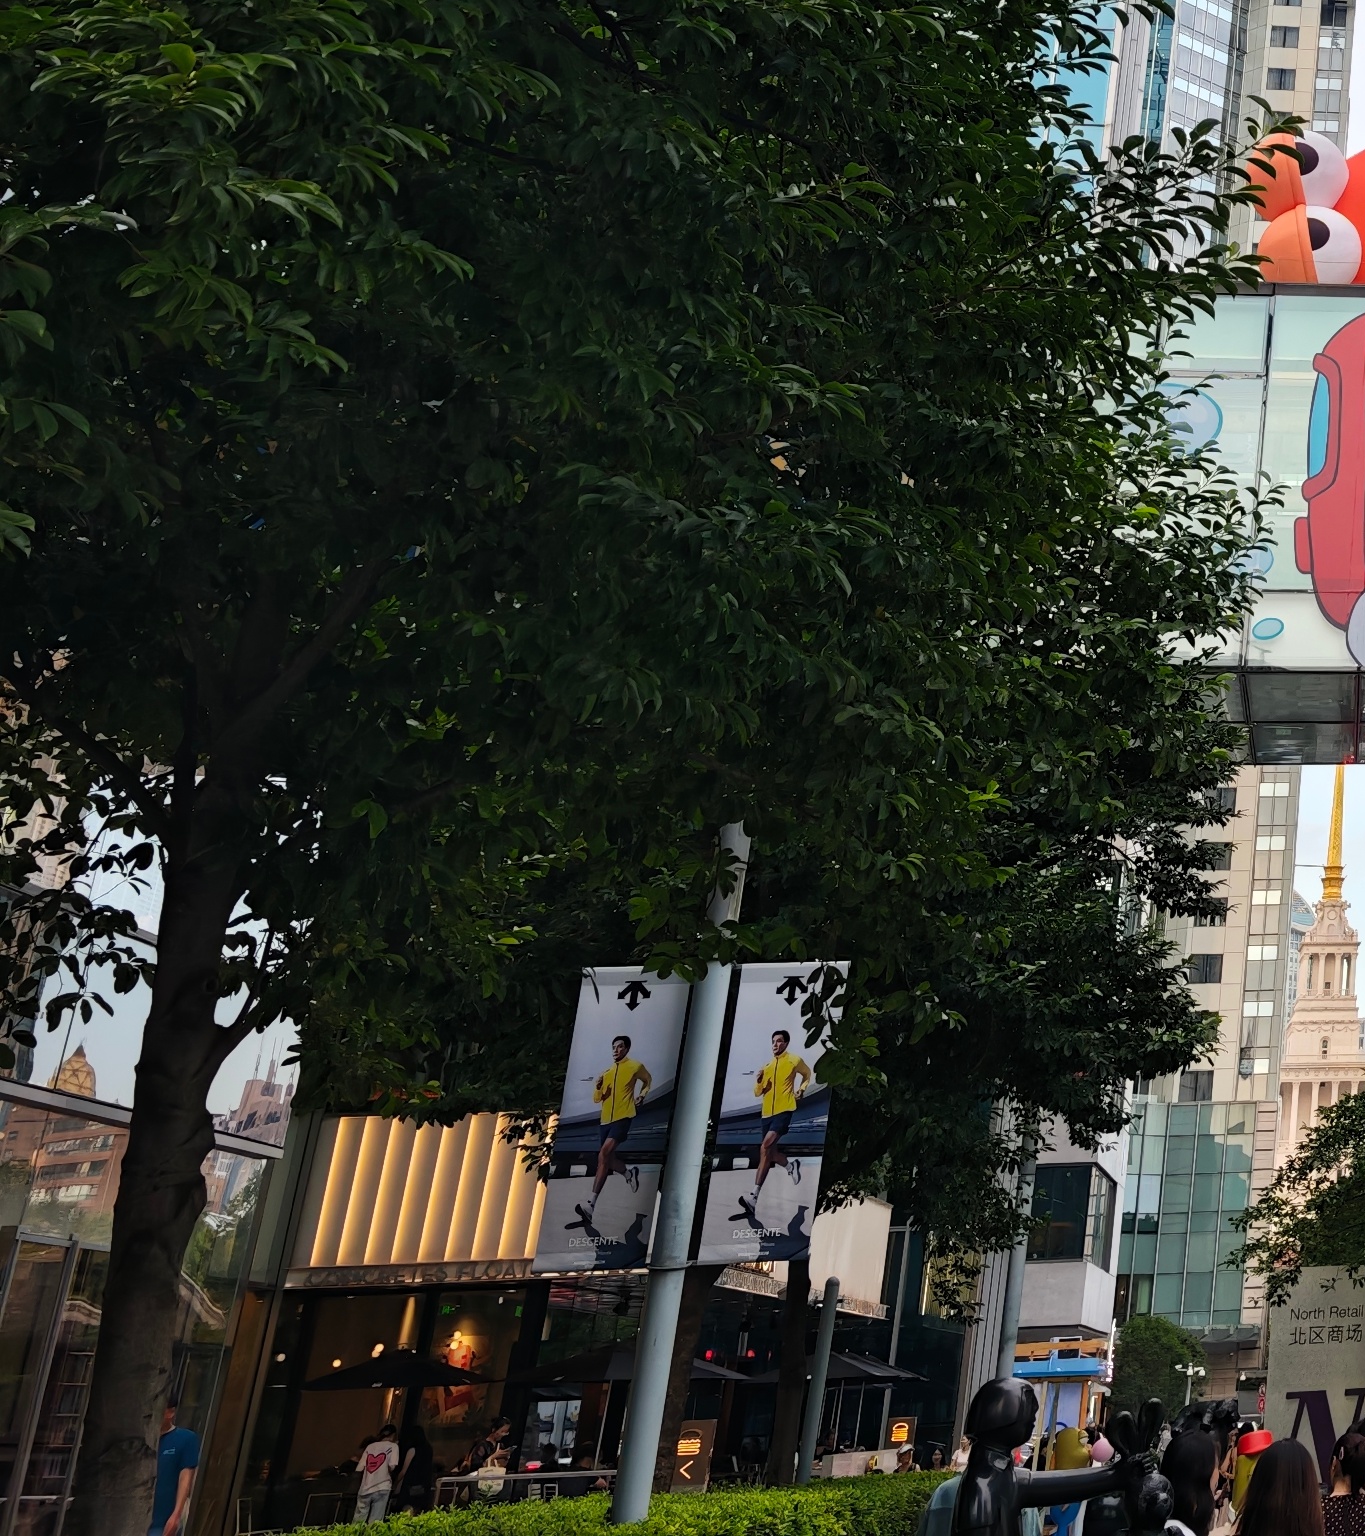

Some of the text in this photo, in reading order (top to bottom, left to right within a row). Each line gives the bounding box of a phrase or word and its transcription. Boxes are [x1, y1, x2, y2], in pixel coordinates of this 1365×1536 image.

[732, 1227, 781, 1239] DESCENTE
[568, 1236, 619, 1248] DESCENTE
[1290, 1305, 1364, 1321] North Retail
[1288, 1324, 1363, 1346] 北区商场
